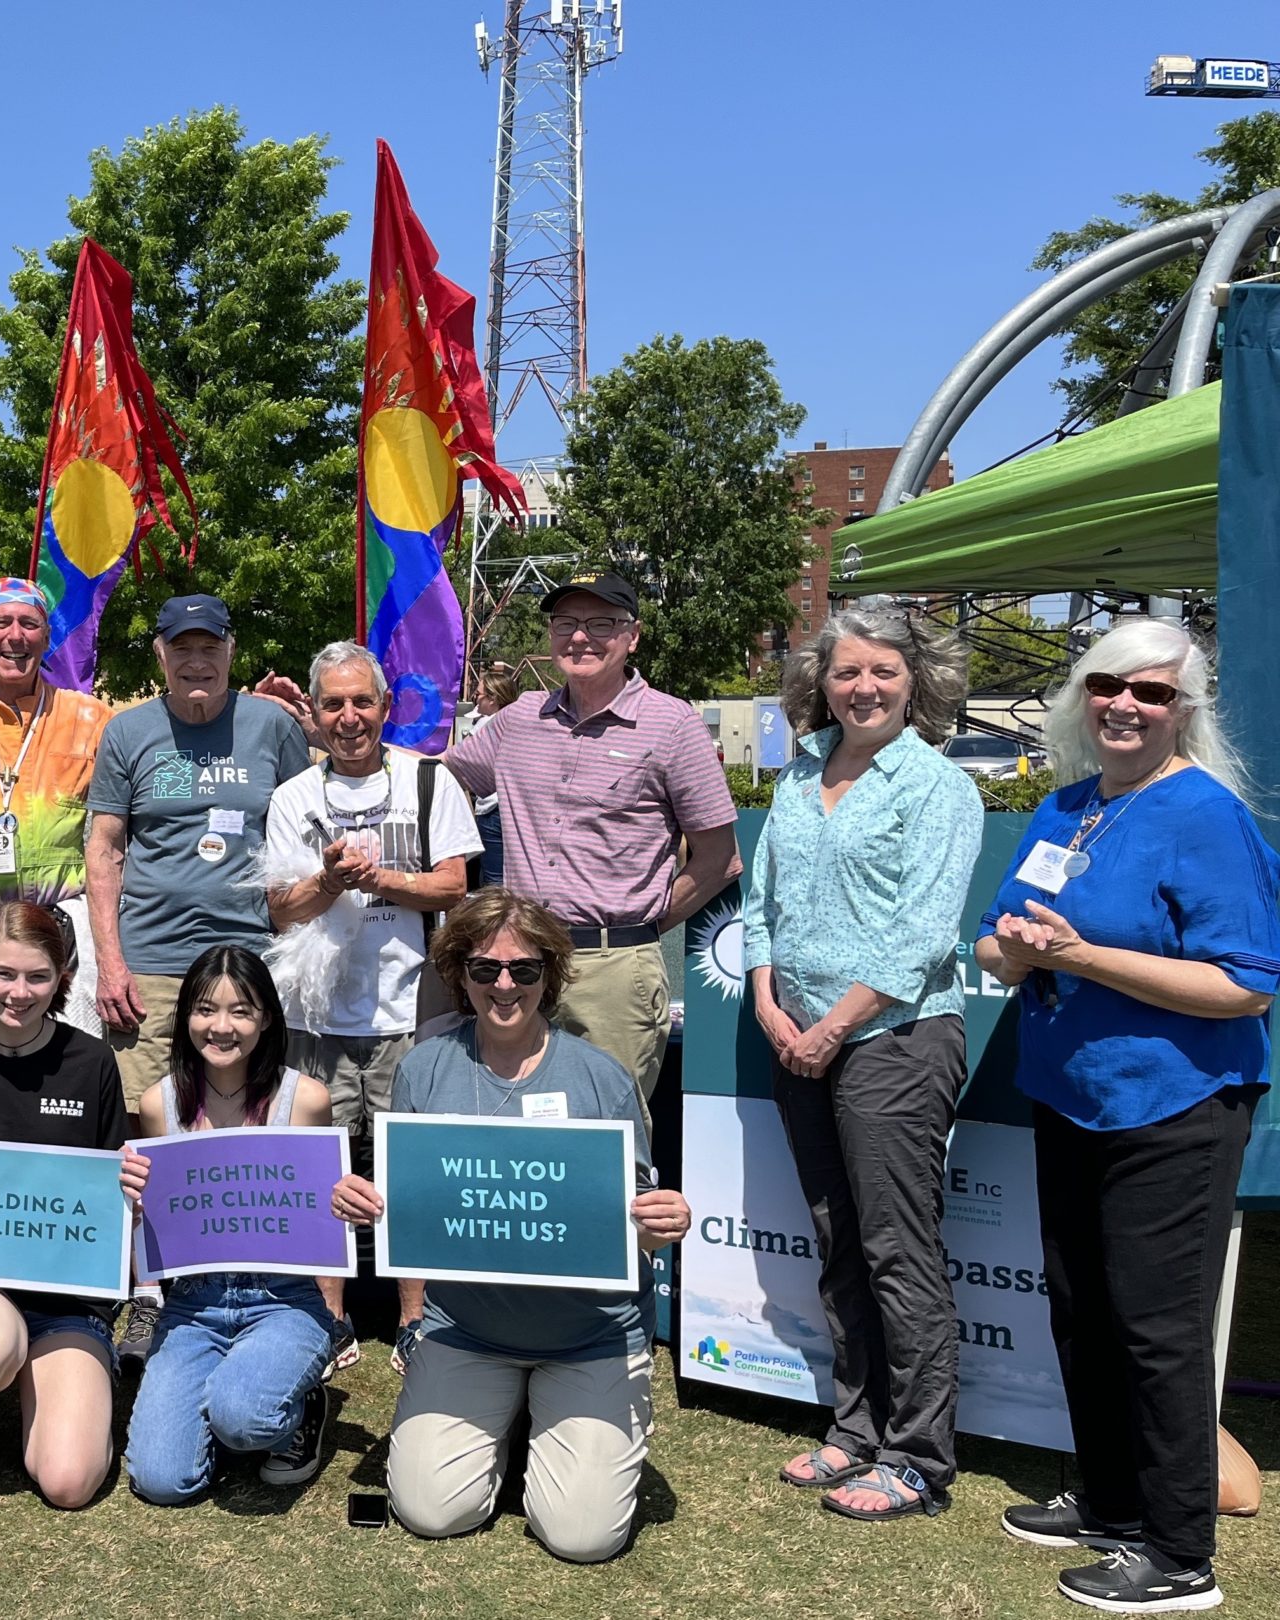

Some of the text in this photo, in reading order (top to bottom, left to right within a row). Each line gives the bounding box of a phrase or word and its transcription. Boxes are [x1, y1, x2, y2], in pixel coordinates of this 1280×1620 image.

[1210, 65, 1265, 82] HEEDE
[199, 751, 235, 765] clean
[198, 766, 249, 784] AIRE
[198, 786, 216, 795] nc
[40, 1097, 84, 1109] EARTH
[40, 1105, 83, 1117] MATTERS
[186, 1164, 296, 1186] FIGHTING
[441, 1157, 566, 1182] WILL YOU
[975, 1182, 1002, 1197] nc
[72, 1199, 88, 1216] A
[169, 1191, 317, 1214] FOR CLIMATE
[460, 1188, 548, 1211] STAND
[64, 1225, 97, 1243] NC
[200, 1217, 290, 1236] JUSTICE
[443, 1217, 567, 1243] WITH US?
[700, 1216, 823, 1261] Clima
[734, 1350, 759, 1362] Path
[760, 1355, 772, 1365] to
[734, 1360, 802, 1381] Communities
